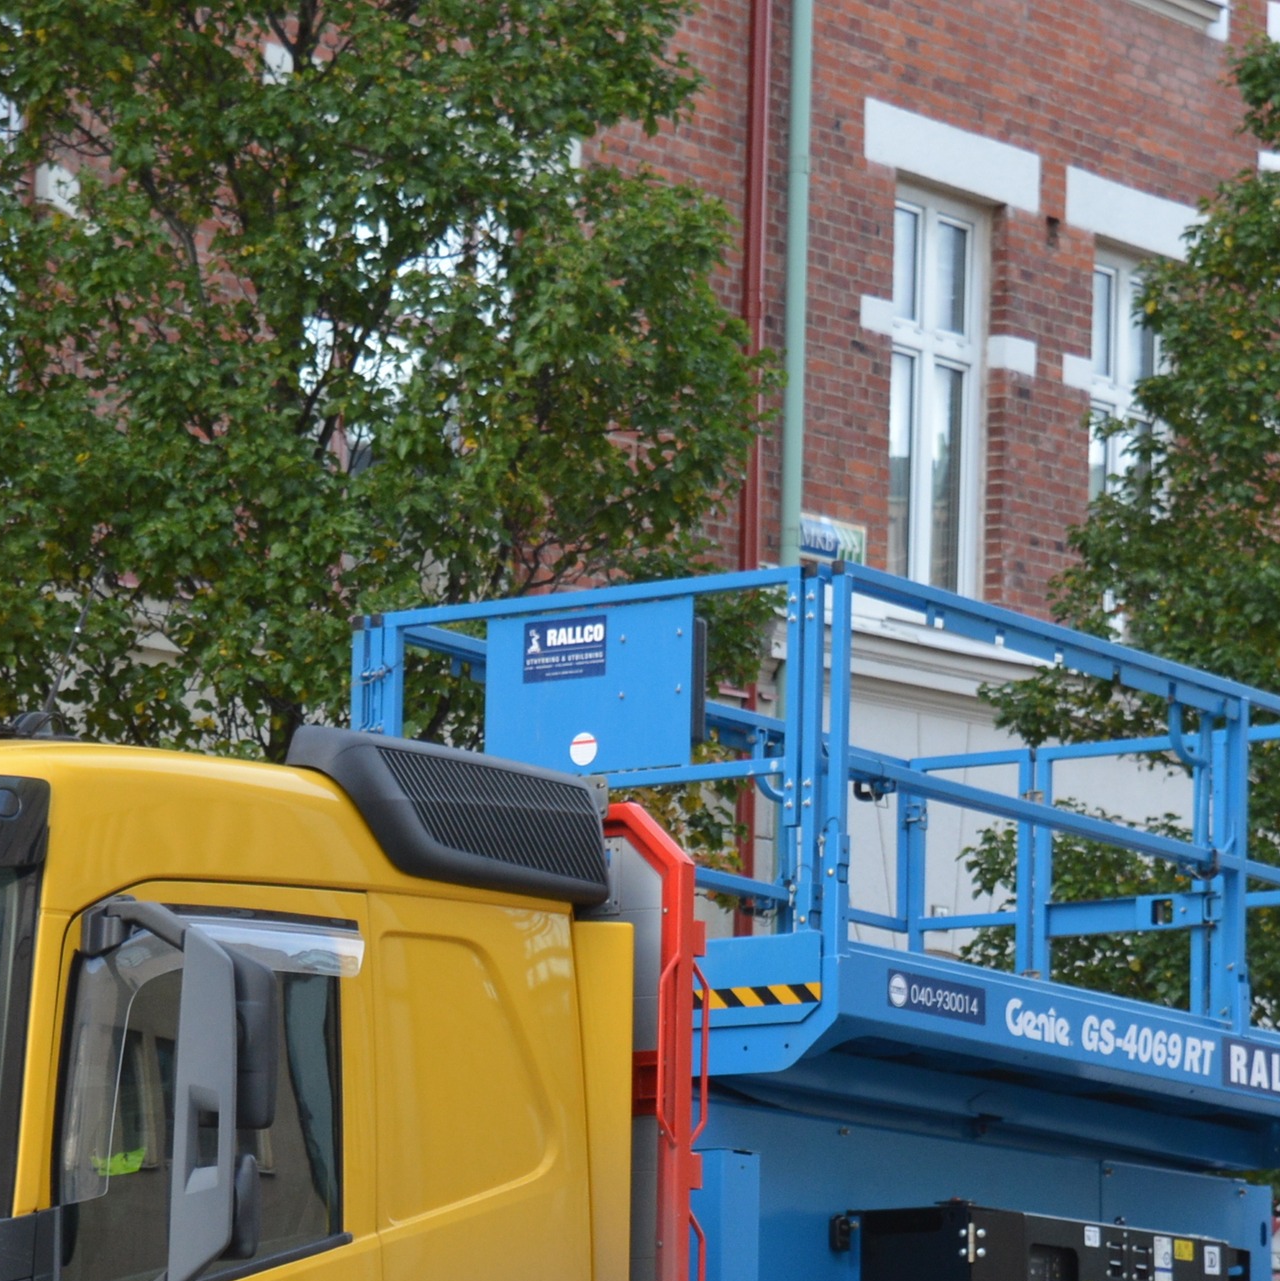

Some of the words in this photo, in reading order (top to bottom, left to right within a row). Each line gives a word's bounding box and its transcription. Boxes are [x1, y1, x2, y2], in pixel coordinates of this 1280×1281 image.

[547, 624, 604, 647] RALLCO
[910, 984, 978, 1015] 040-930014
[1005, 998, 1071, 1046] Genie
